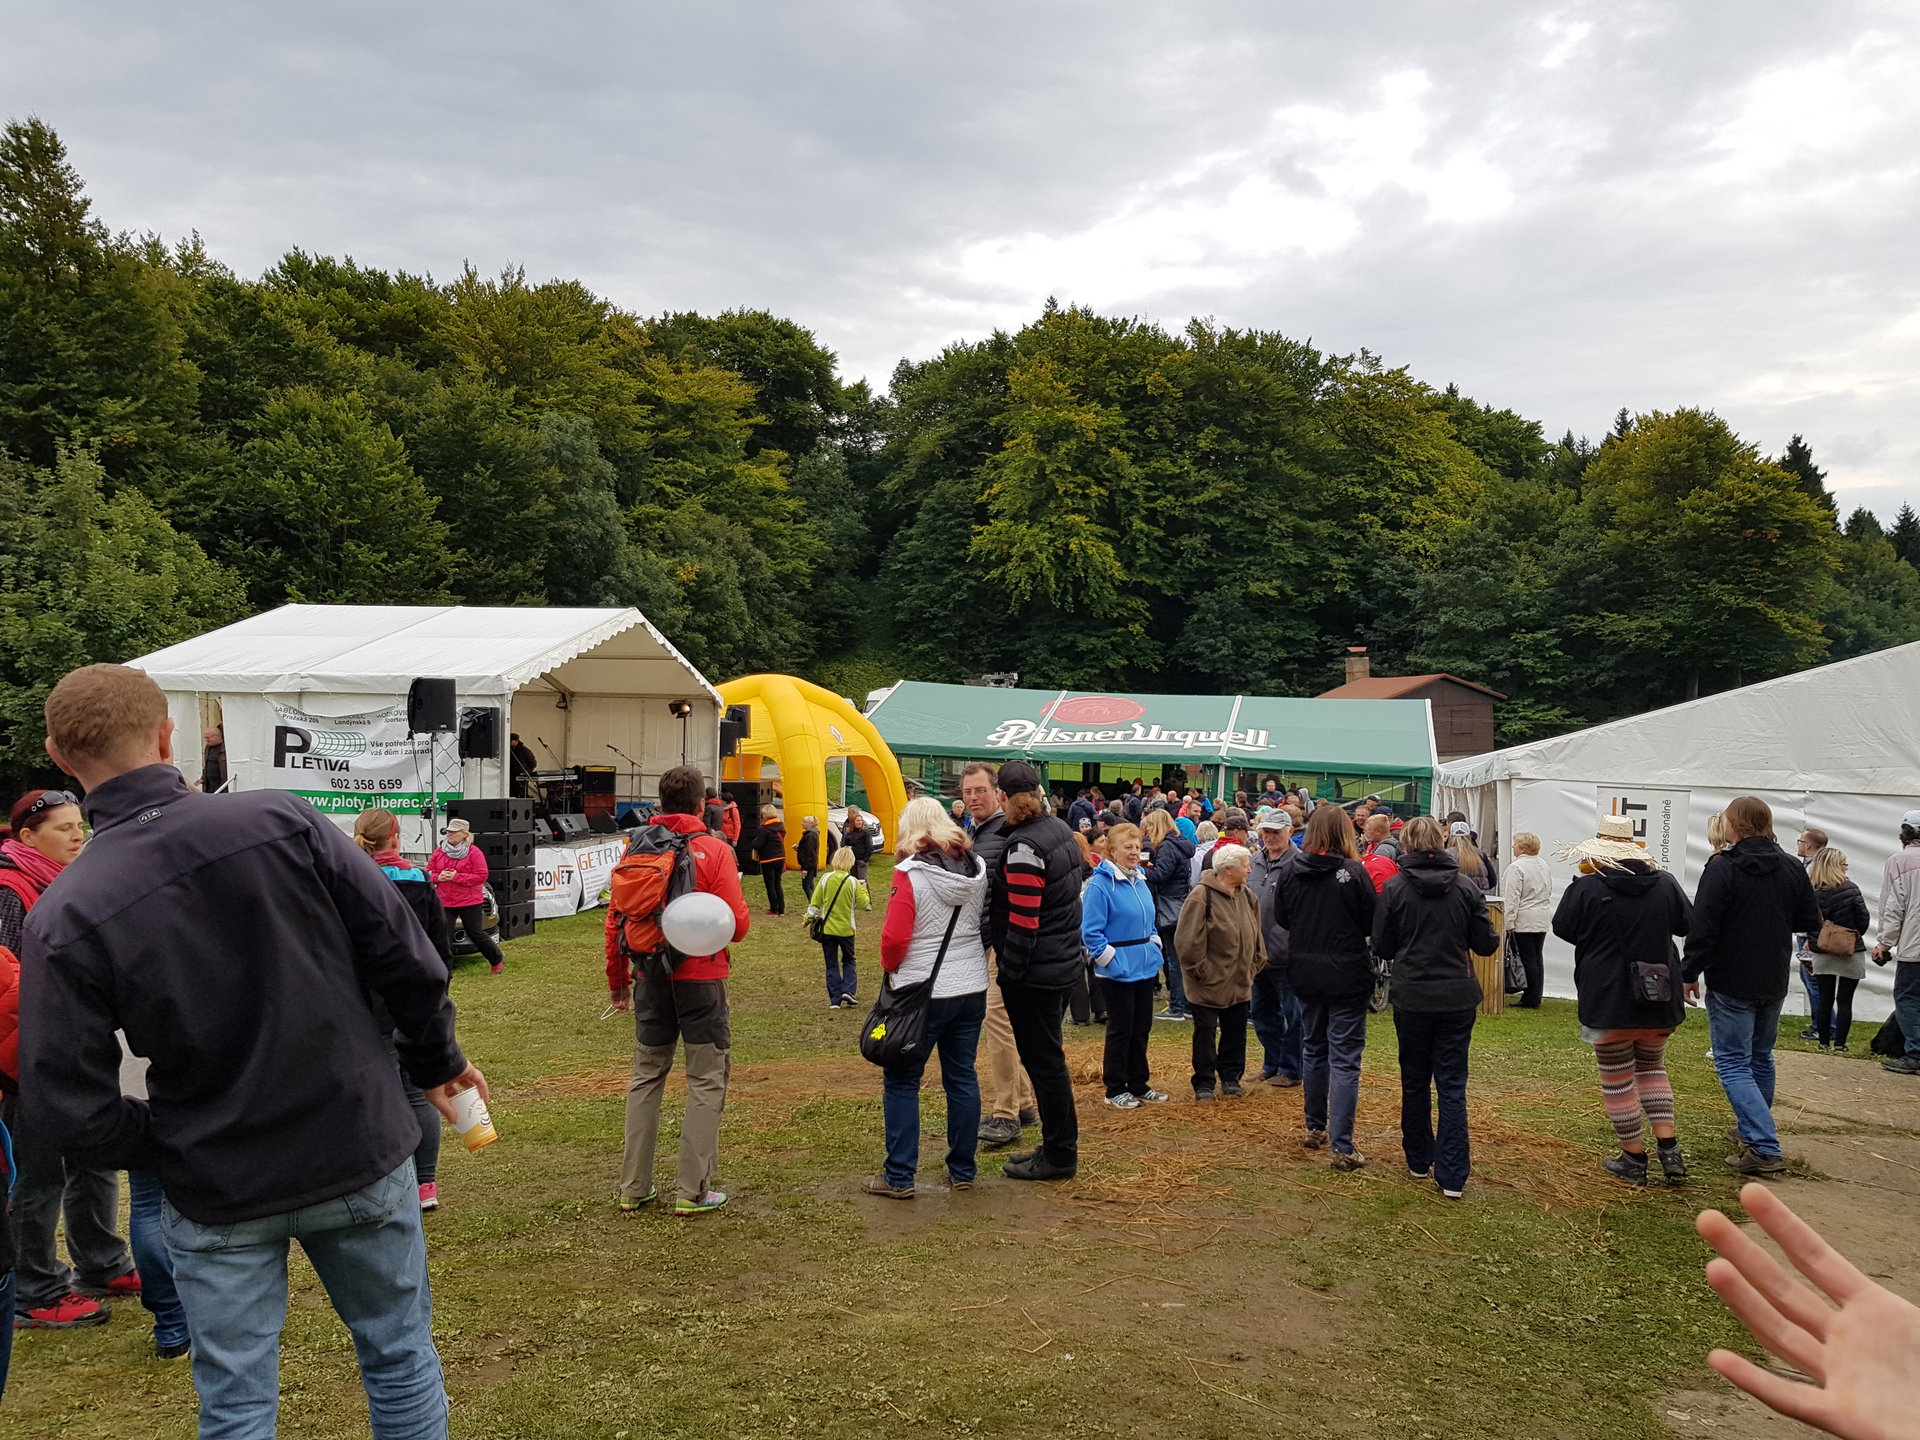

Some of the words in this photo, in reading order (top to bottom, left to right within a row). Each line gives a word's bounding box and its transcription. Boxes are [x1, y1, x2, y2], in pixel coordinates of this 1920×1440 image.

[370, 740, 384, 748] Vše
[417, 740, 430, 748] pro
[984, 719, 1134, 748] Pilsner
[1131, 721, 1269, 749] Urquell
[273, 725, 350, 773] PLETIVA
[384, 747, 400, 756] dům
[330, 777, 351, 790] 602
[353, 778, 375, 791] 358
[378, 778, 403, 790] 659
[1659, 799, 1672, 864] profesionálně
